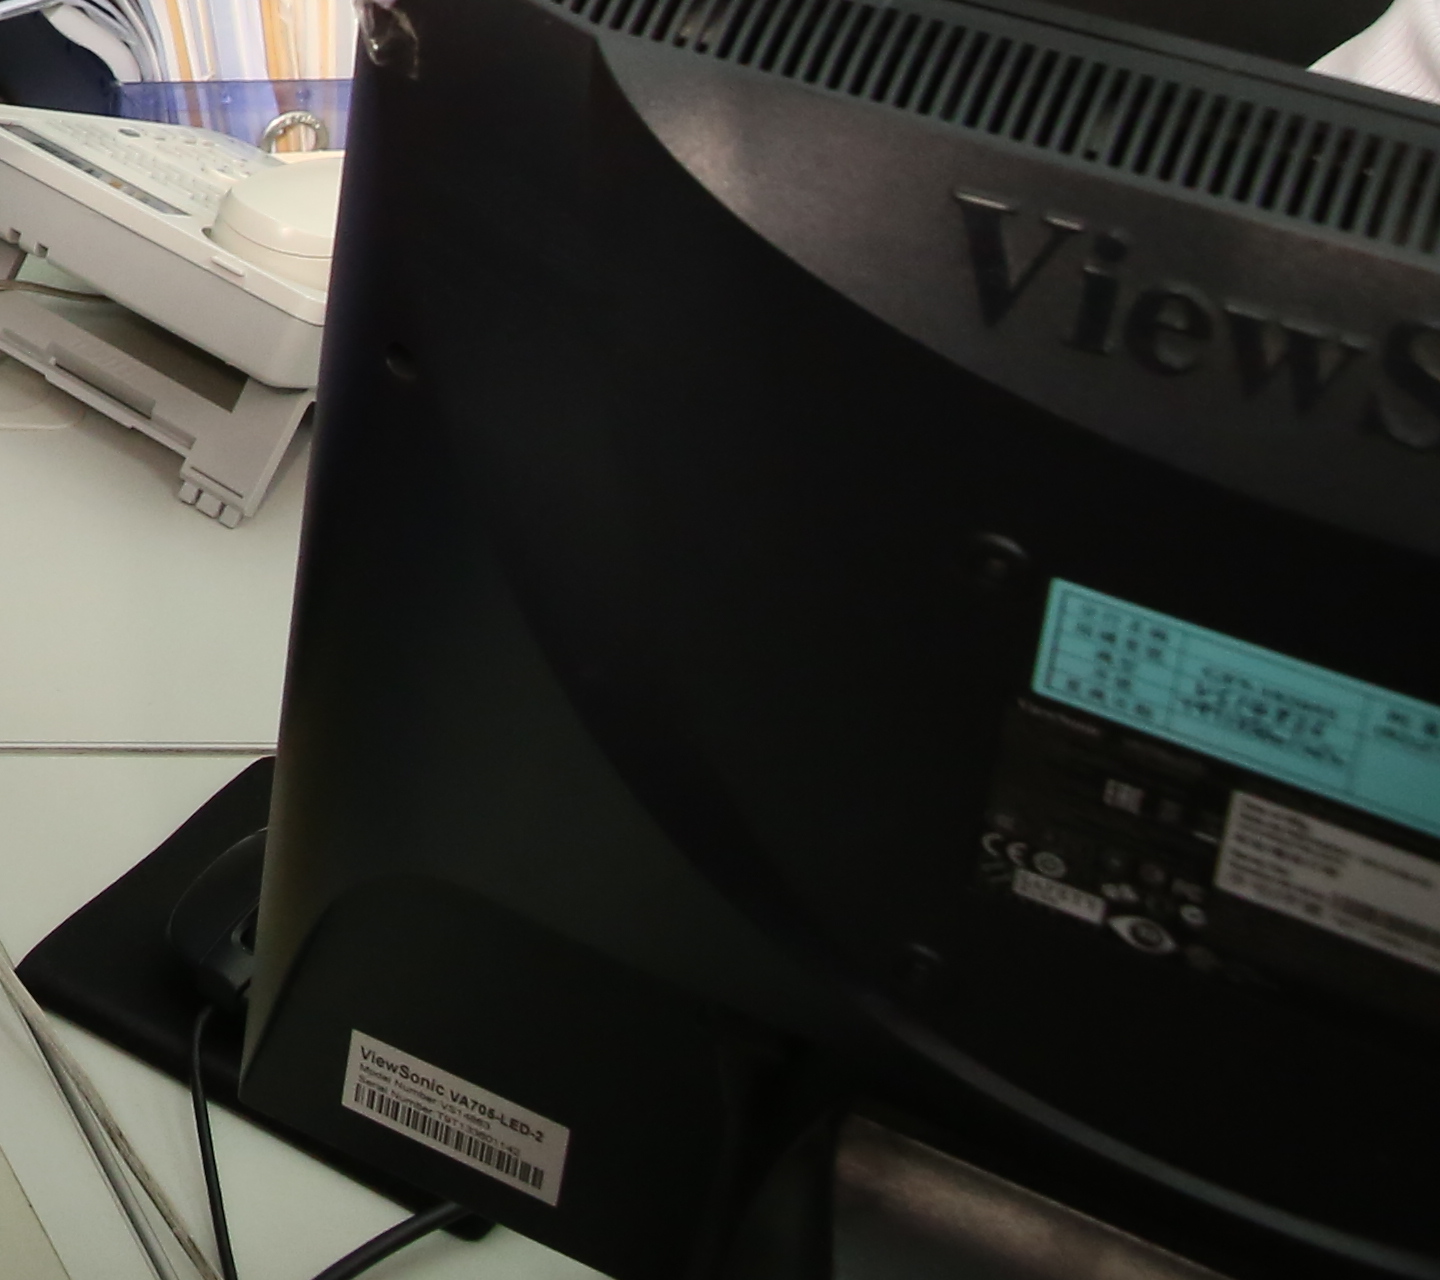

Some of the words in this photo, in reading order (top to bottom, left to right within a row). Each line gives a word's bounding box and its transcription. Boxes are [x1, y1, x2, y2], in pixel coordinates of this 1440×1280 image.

[358, 1074, 389, 1096] Serial
[391, 1088, 434, 1115] Number
[360, 1062, 391, 1085] Model
[395, 1079, 437, 1106] Number
[360, 1045, 445, 1096] ViewSonic
[450, 1089, 544, 1143] VA705-LED-2
